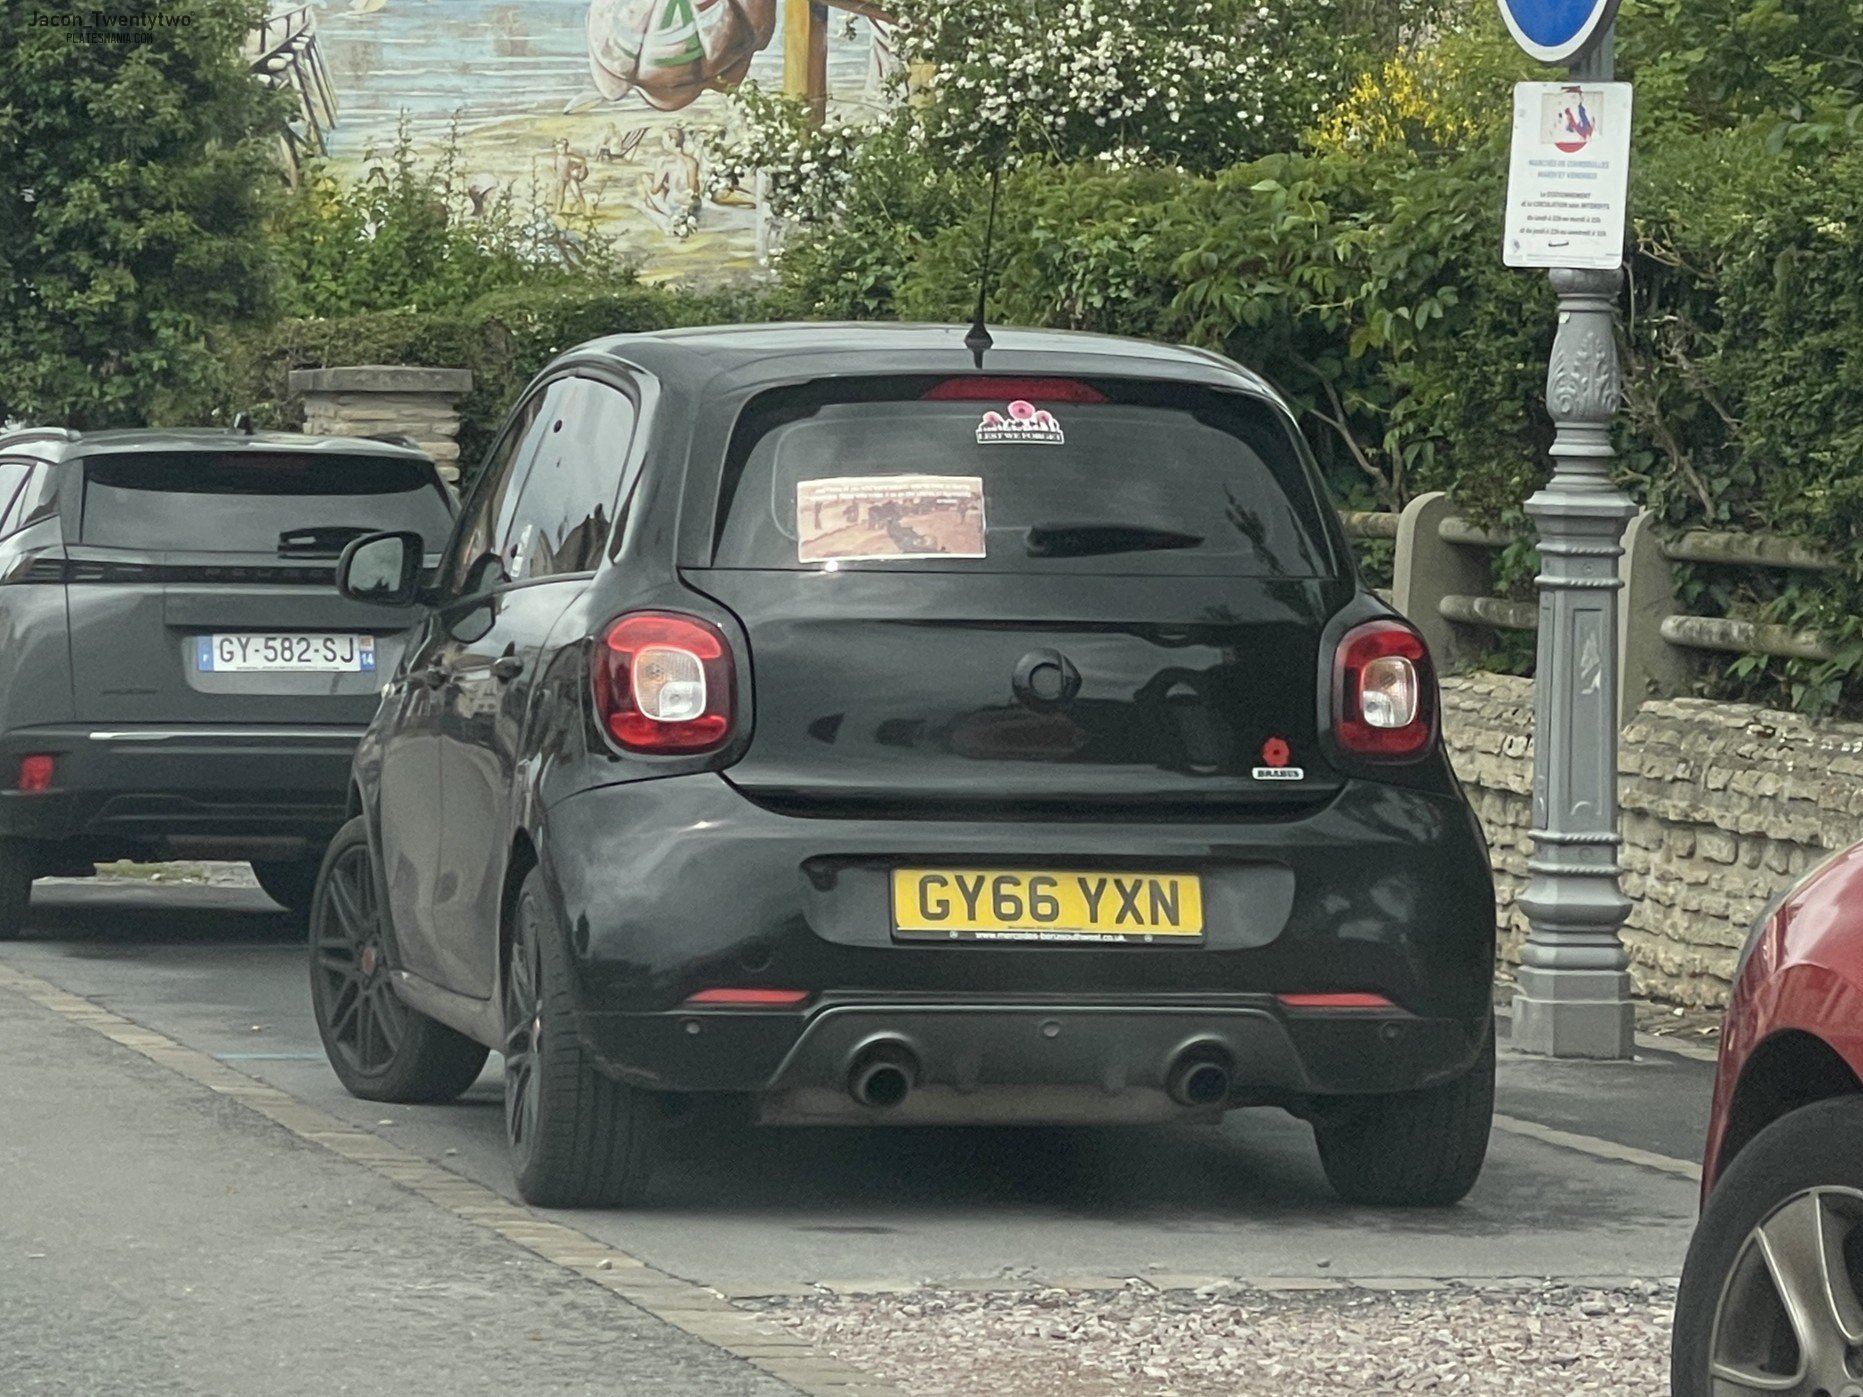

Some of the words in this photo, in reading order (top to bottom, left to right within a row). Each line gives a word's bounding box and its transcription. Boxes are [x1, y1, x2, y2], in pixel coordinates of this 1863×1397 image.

[219, 637, 355, 663] GY-582-SJ
[361, 653, 374, 665] 14
[918, 875, 1060, 922] GY66
[1077, 876, 1181, 926] YXN
